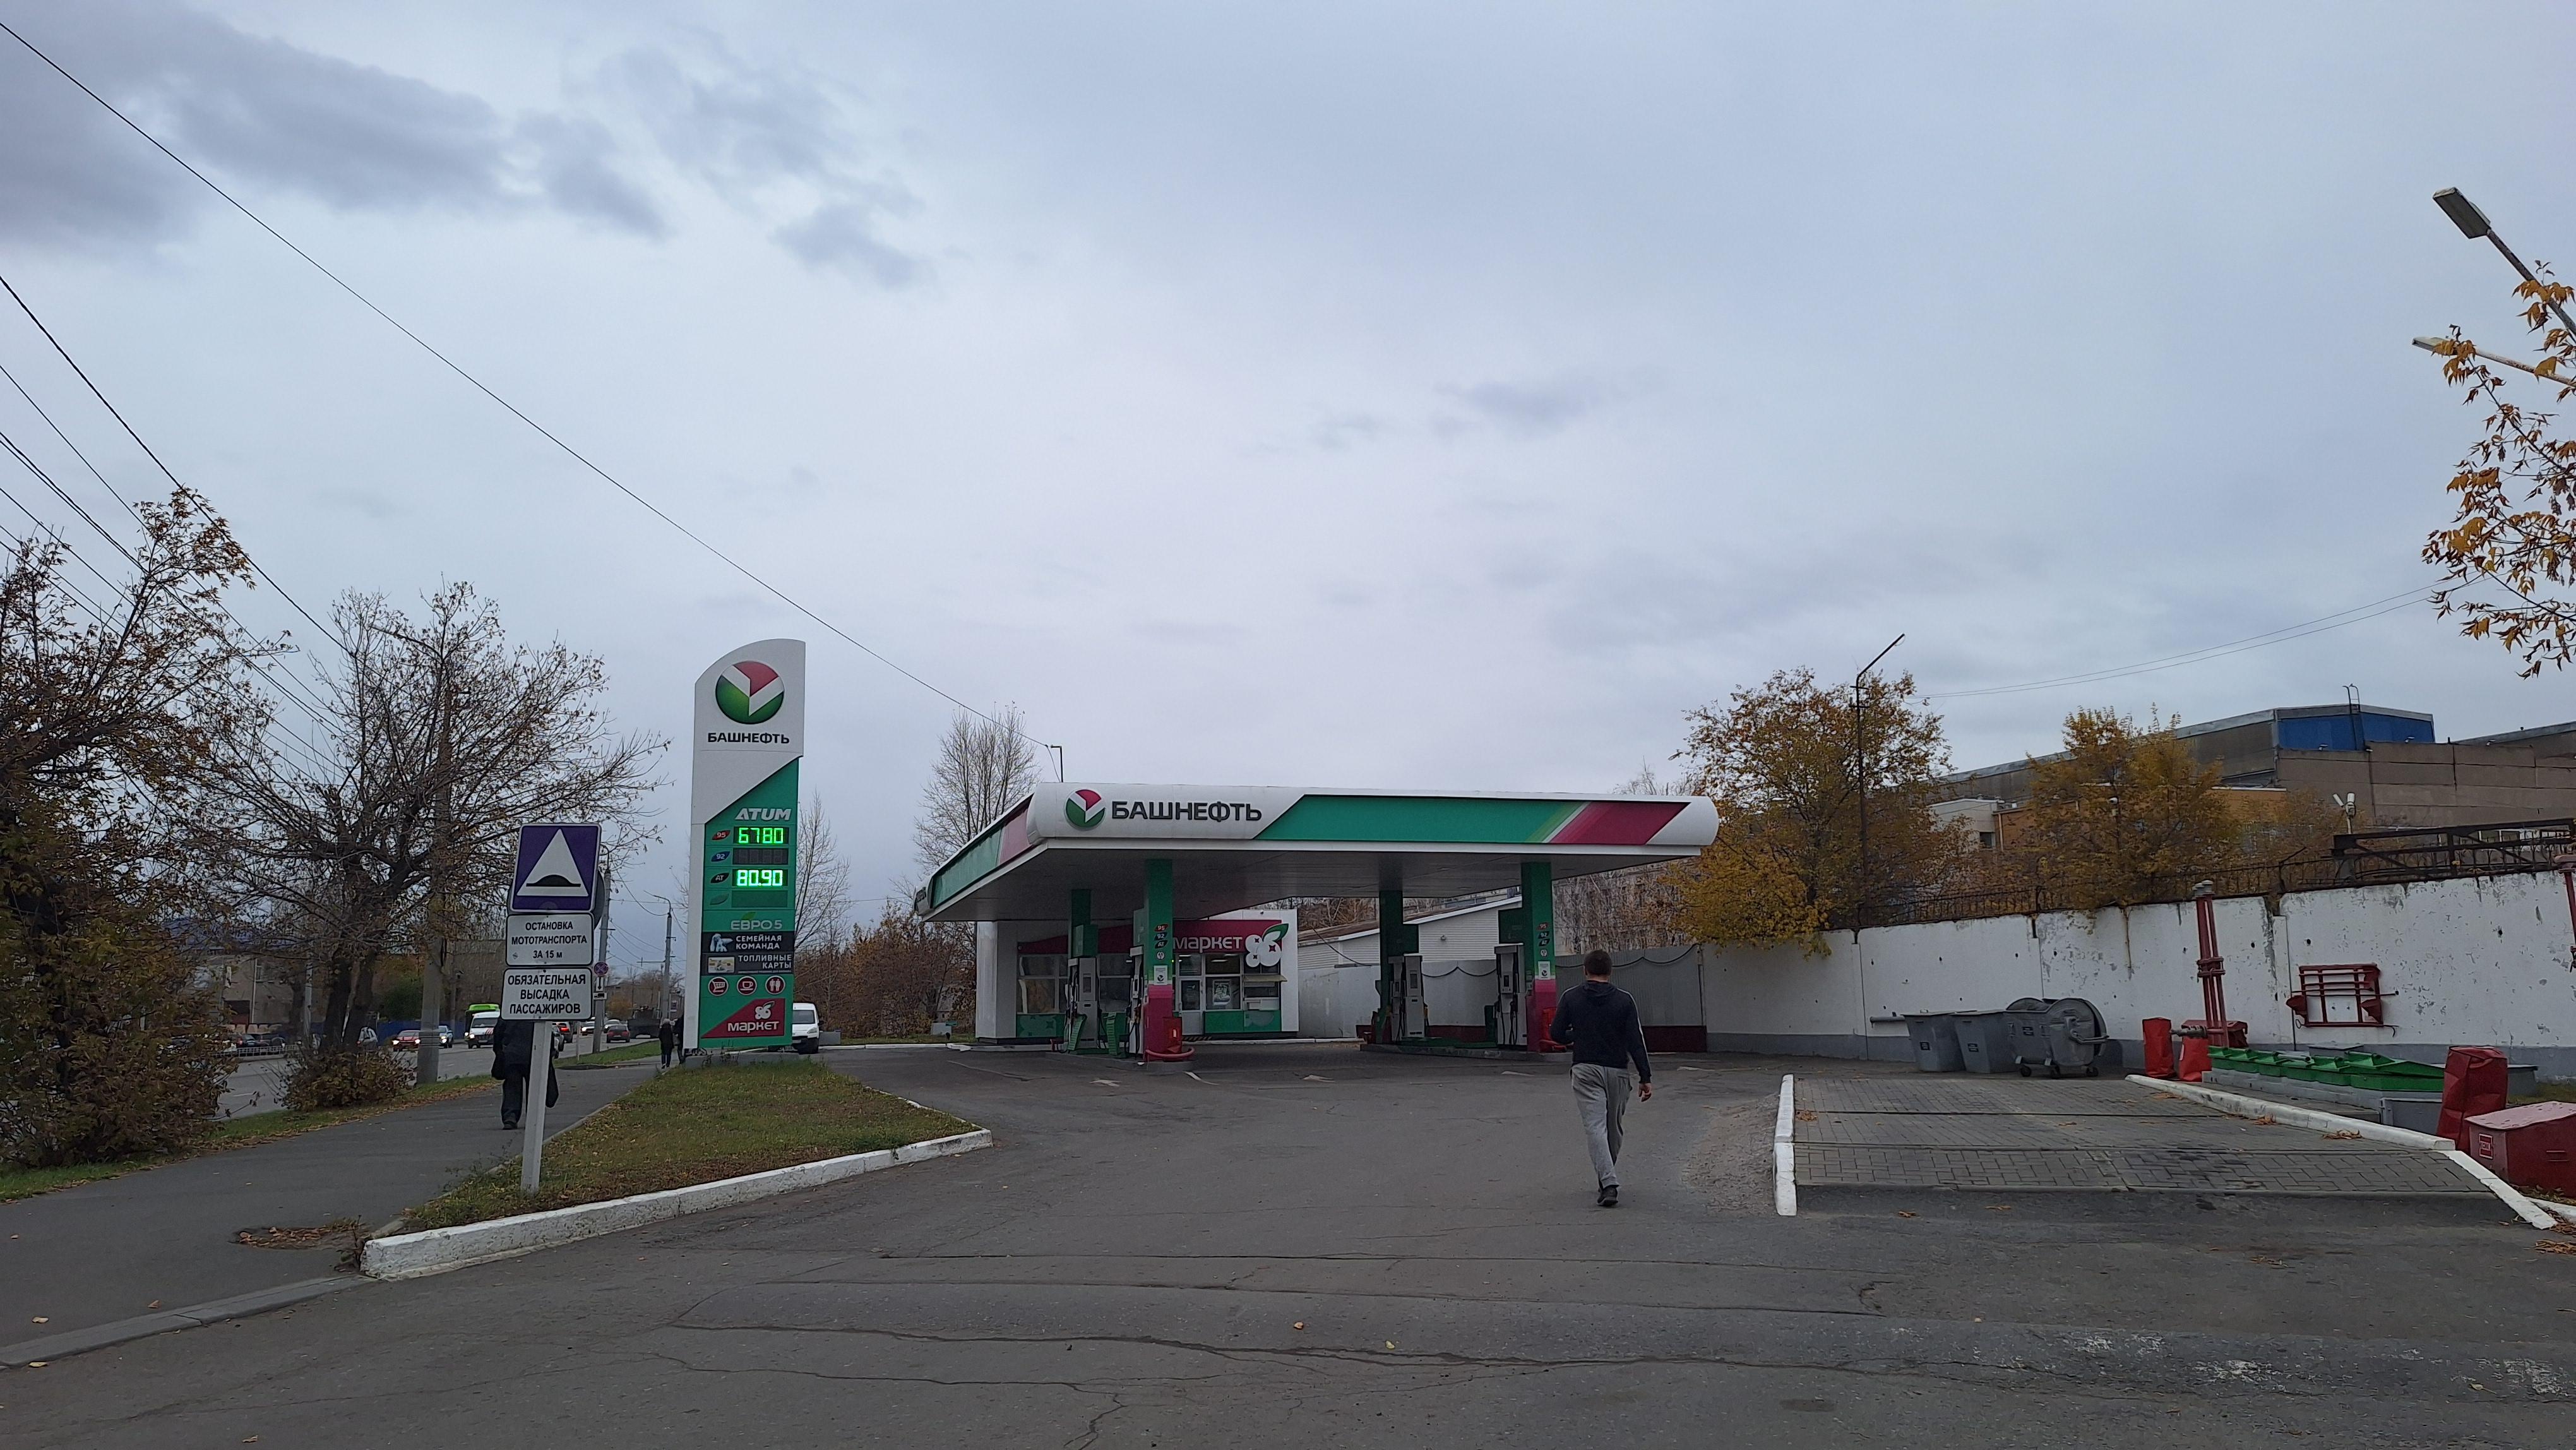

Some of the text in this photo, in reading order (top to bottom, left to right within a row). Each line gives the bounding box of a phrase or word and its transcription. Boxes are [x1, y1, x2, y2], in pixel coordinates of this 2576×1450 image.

[707, 733, 790, 744] БАШНЕФТЬ
[734, 808, 792, 820] ATUM
[1111, 801, 1262, 822] БАШНЕФТЬ
[737, 870, 783, 886] 80.90
[525, 921, 573, 930] ОСТАНОВКА
[730, 920, 783, 930] ЕВРО 5
[511, 935, 587, 945] МОТОТРАНСПОРТА
[533, 950, 543, 959] ЗА
[508, 974, 586, 985] ОБЯЗАТЕЛЬНАЯ
[520, 989, 570, 1001] ВЫСАДКА
[510, 1004, 581, 1014] ПАССАЖИРОВ
